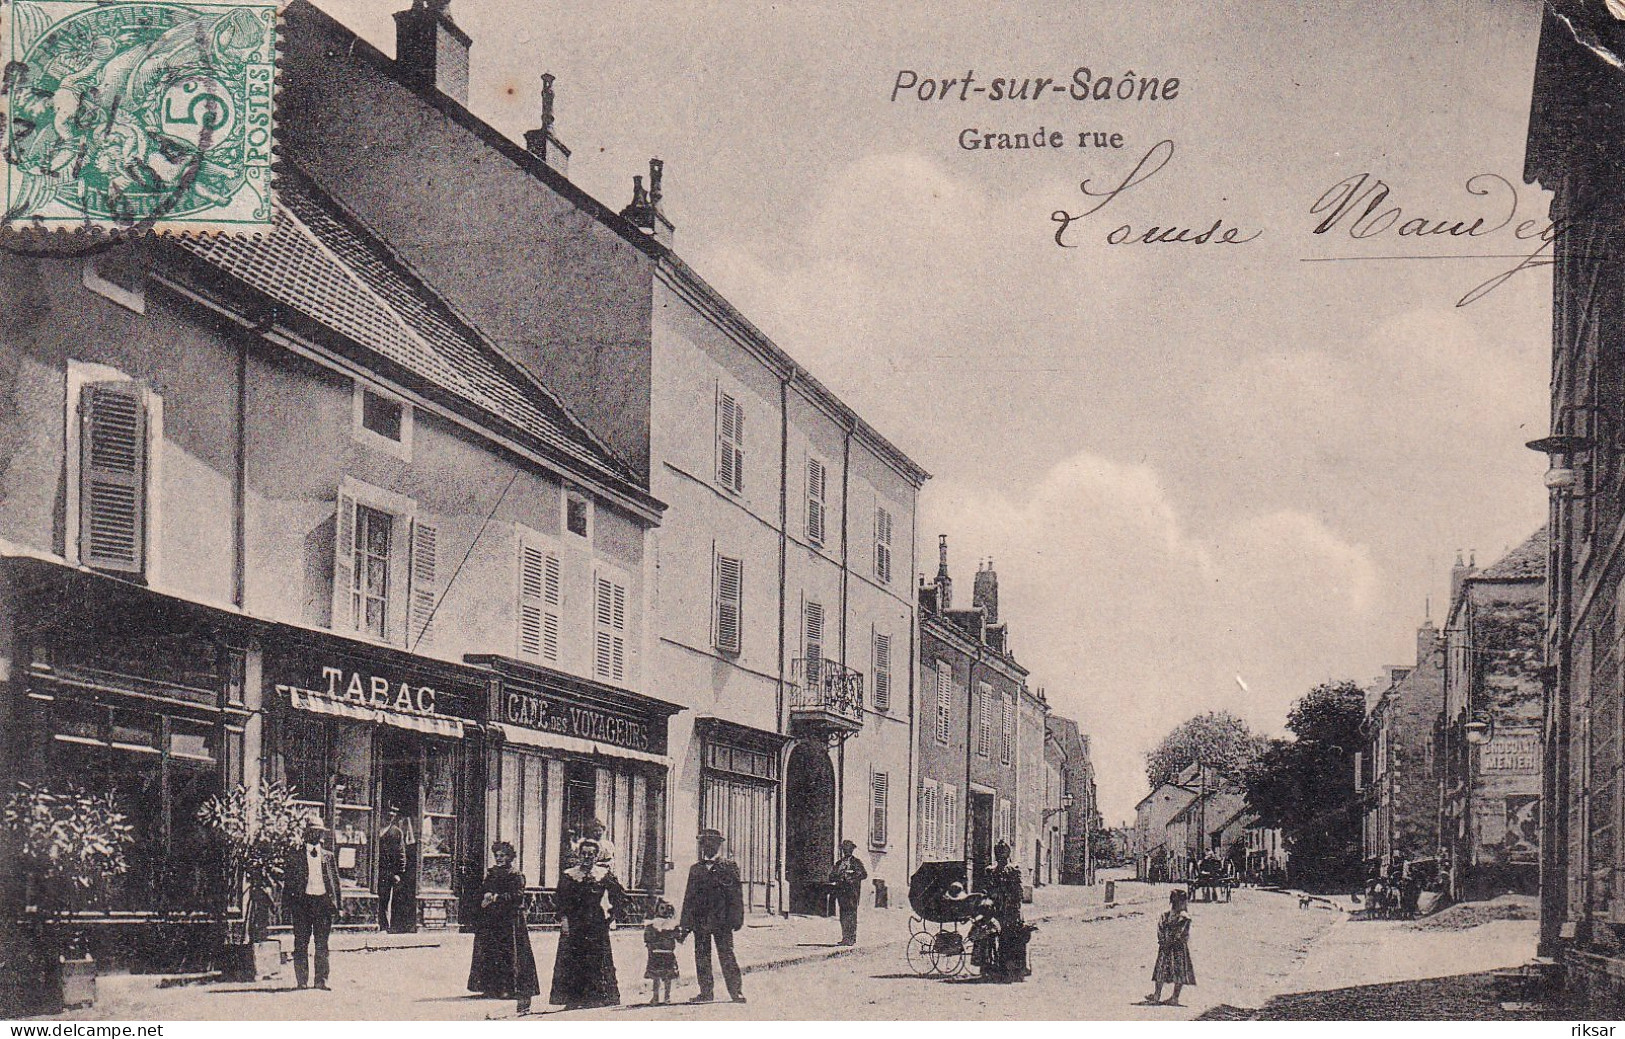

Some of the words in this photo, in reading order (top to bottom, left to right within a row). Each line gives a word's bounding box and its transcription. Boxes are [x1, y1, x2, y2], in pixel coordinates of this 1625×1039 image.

[250, 68, 269, 163] POSTES
[322, 665, 437, 716] TABAC
[550, 716, 568, 733] DES
[569, 707, 650, 750] VOYAGEURS
[1487, 756, 1536, 770] MENIER
